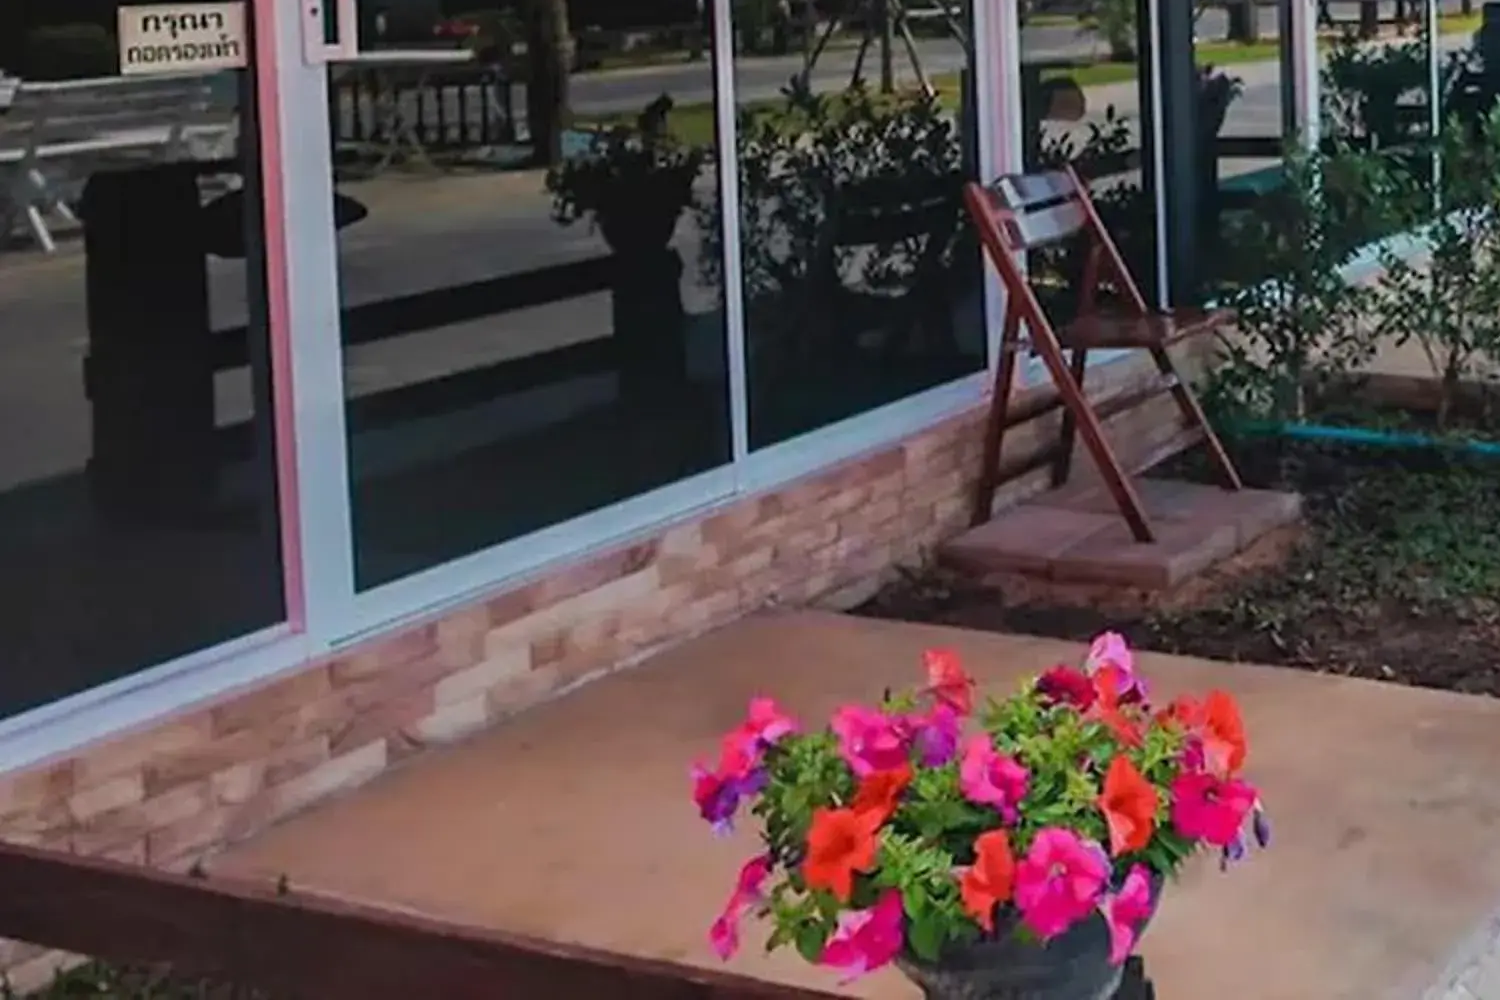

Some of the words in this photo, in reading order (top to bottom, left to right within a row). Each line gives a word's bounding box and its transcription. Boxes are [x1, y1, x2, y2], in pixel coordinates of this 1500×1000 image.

[142, 11, 224, 38] กรุณา
[127, 34, 240, 64] ถอดรองเท้า
